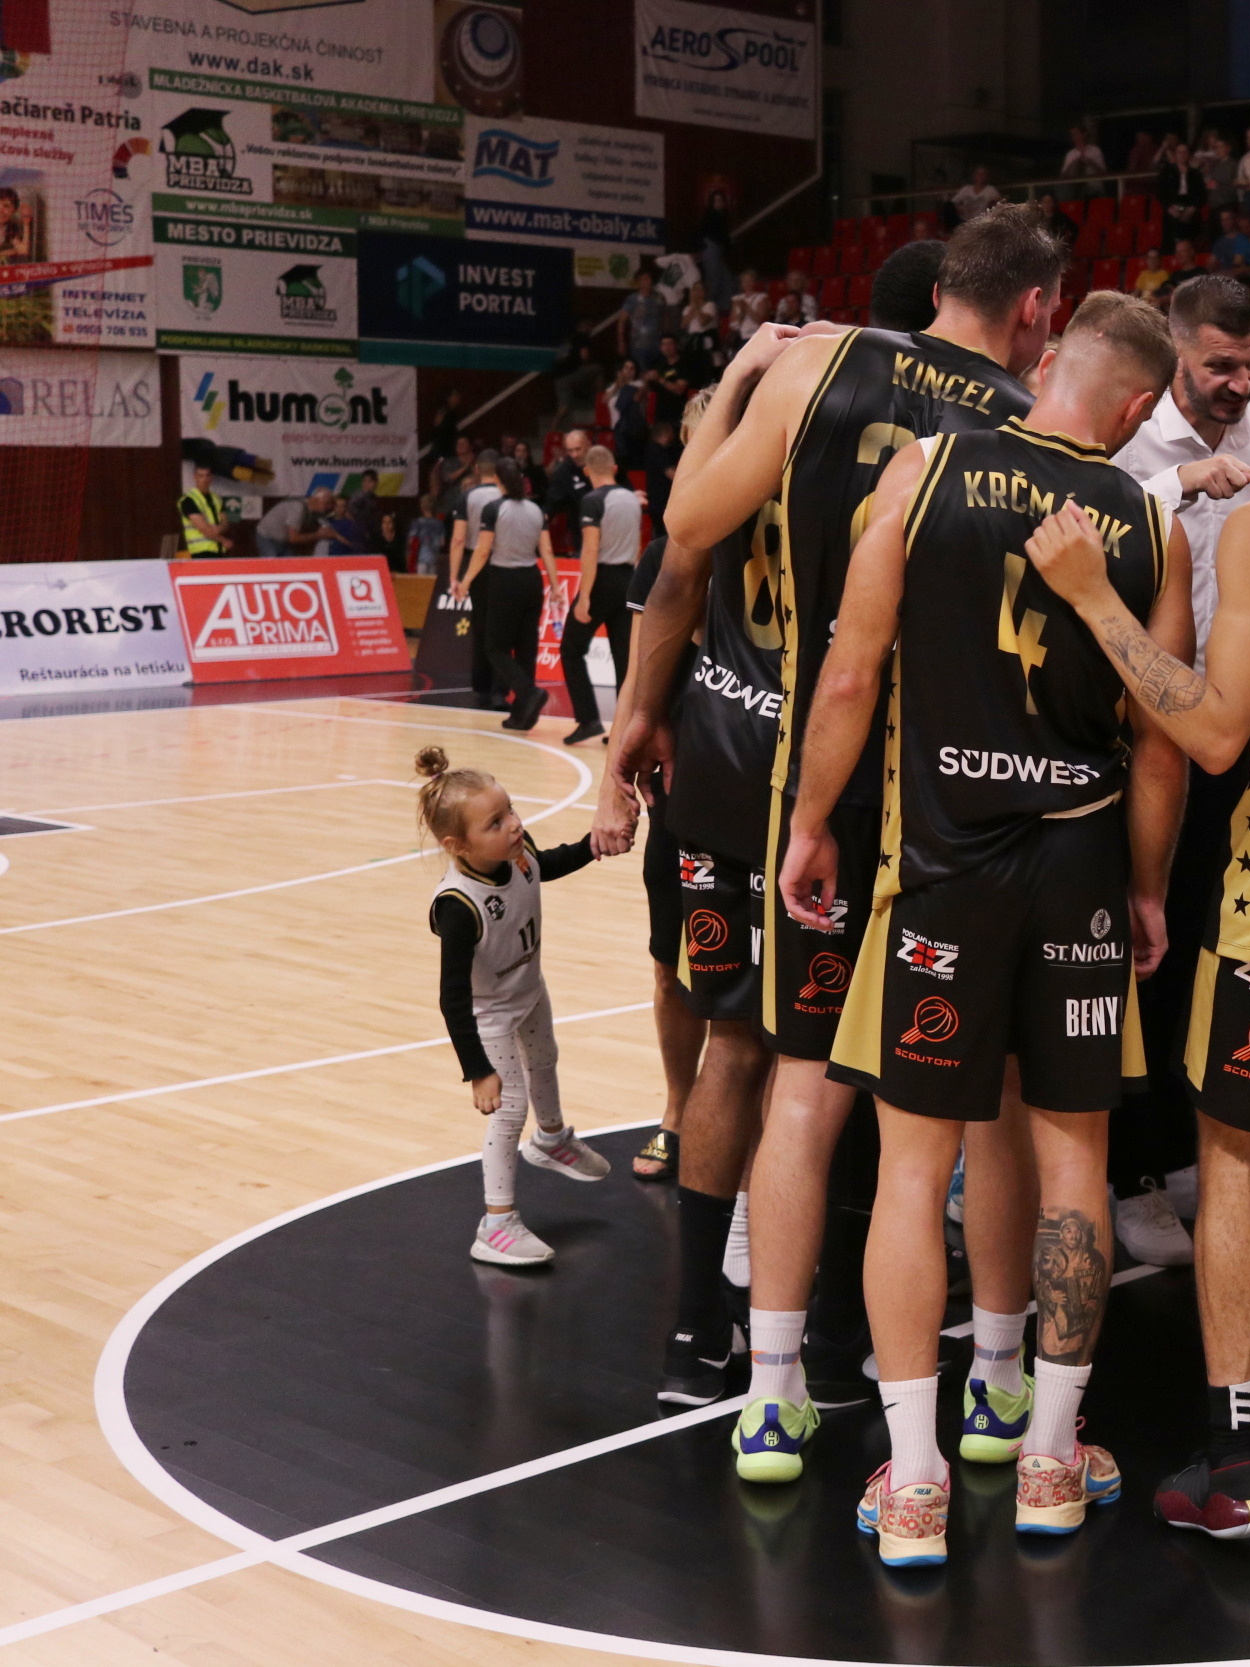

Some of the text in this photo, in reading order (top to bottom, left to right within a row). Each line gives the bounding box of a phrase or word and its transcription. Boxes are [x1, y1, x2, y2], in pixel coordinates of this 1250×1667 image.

[109, 11, 198, 37] STAVEBNÁ
[201, 25, 213, 39] A
[215, 26, 311, 52] PROJEKČNÁ
[188, 51, 314, 82] www.dak.sk
[81, 106, 141, 131] Patria
[168, 155, 220, 176] MBA
[474, 138, 558, 178] MAT
[169, 174, 251, 193] PRIEVIDZA
[75, 200, 134, 224] TIMES
[185, 201, 313, 221] www.mbaprievidza.sk
[473, 206, 658, 240] www.mat-obaly.sk
[167, 222, 343, 252] MESTO PRIEVIDZA
[459, 264, 535, 288] INVEST
[62, 289, 147, 304] INTERNET
[459, 292, 536, 316] PORTAL
[63, 305, 147, 321] TELEVÍZIA
[891, 352, 996, 415] KINCEL
[31, 377, 151, 419] RELAS
[228, 379, 388, 426] humont
[291, 454, 408, 469] www.humont.sk
[964, 469, 1133, 558] KRČMIK
[0, 603, 168, 639] ROREST
[194, 582, 319, 647] AUTO
[246, 620, 329, 644] PRIMA
[20, 660, 185, 682] Reštaurácia na letisku
[695, 656, 782, 719] SÜDWE
[938, 746, 1100, 786] SÜDWEST
[933, 941, 960, 951] DVERE
[937, 973, 954, 981] 1998
[1066, 996, 1119, 1037] BENY
[894, 1047, 962, 1068] SCOUTORY
